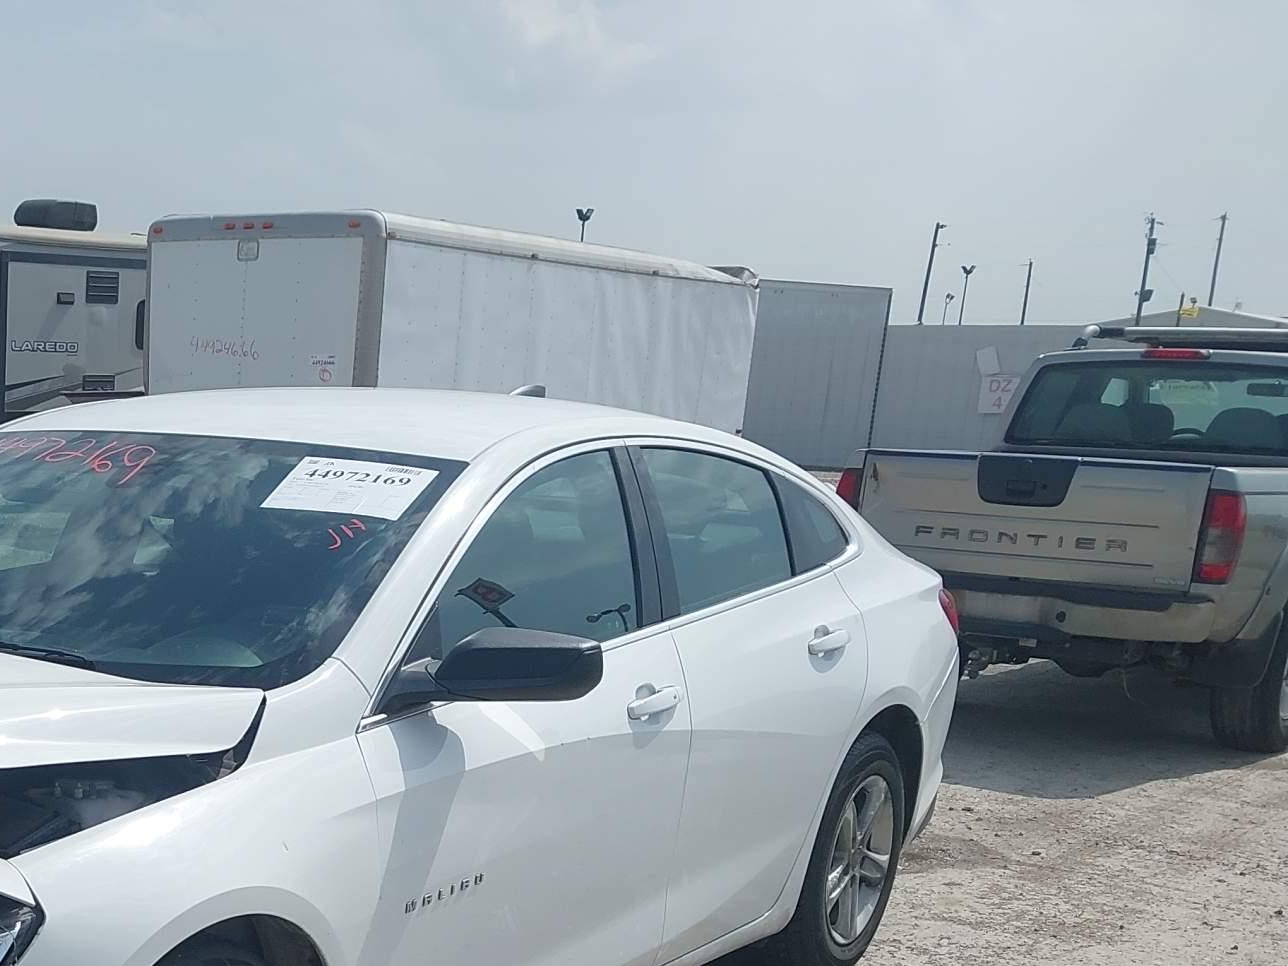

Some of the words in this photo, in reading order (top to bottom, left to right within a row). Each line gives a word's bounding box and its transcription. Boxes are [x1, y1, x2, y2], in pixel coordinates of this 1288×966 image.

[11, 340, 79, 354] LAREDO
[992, 396, 1003, 410] 4
[303, 467, 412, 488] 44972169
[914, 524, 1129, 553] FRONTIER
